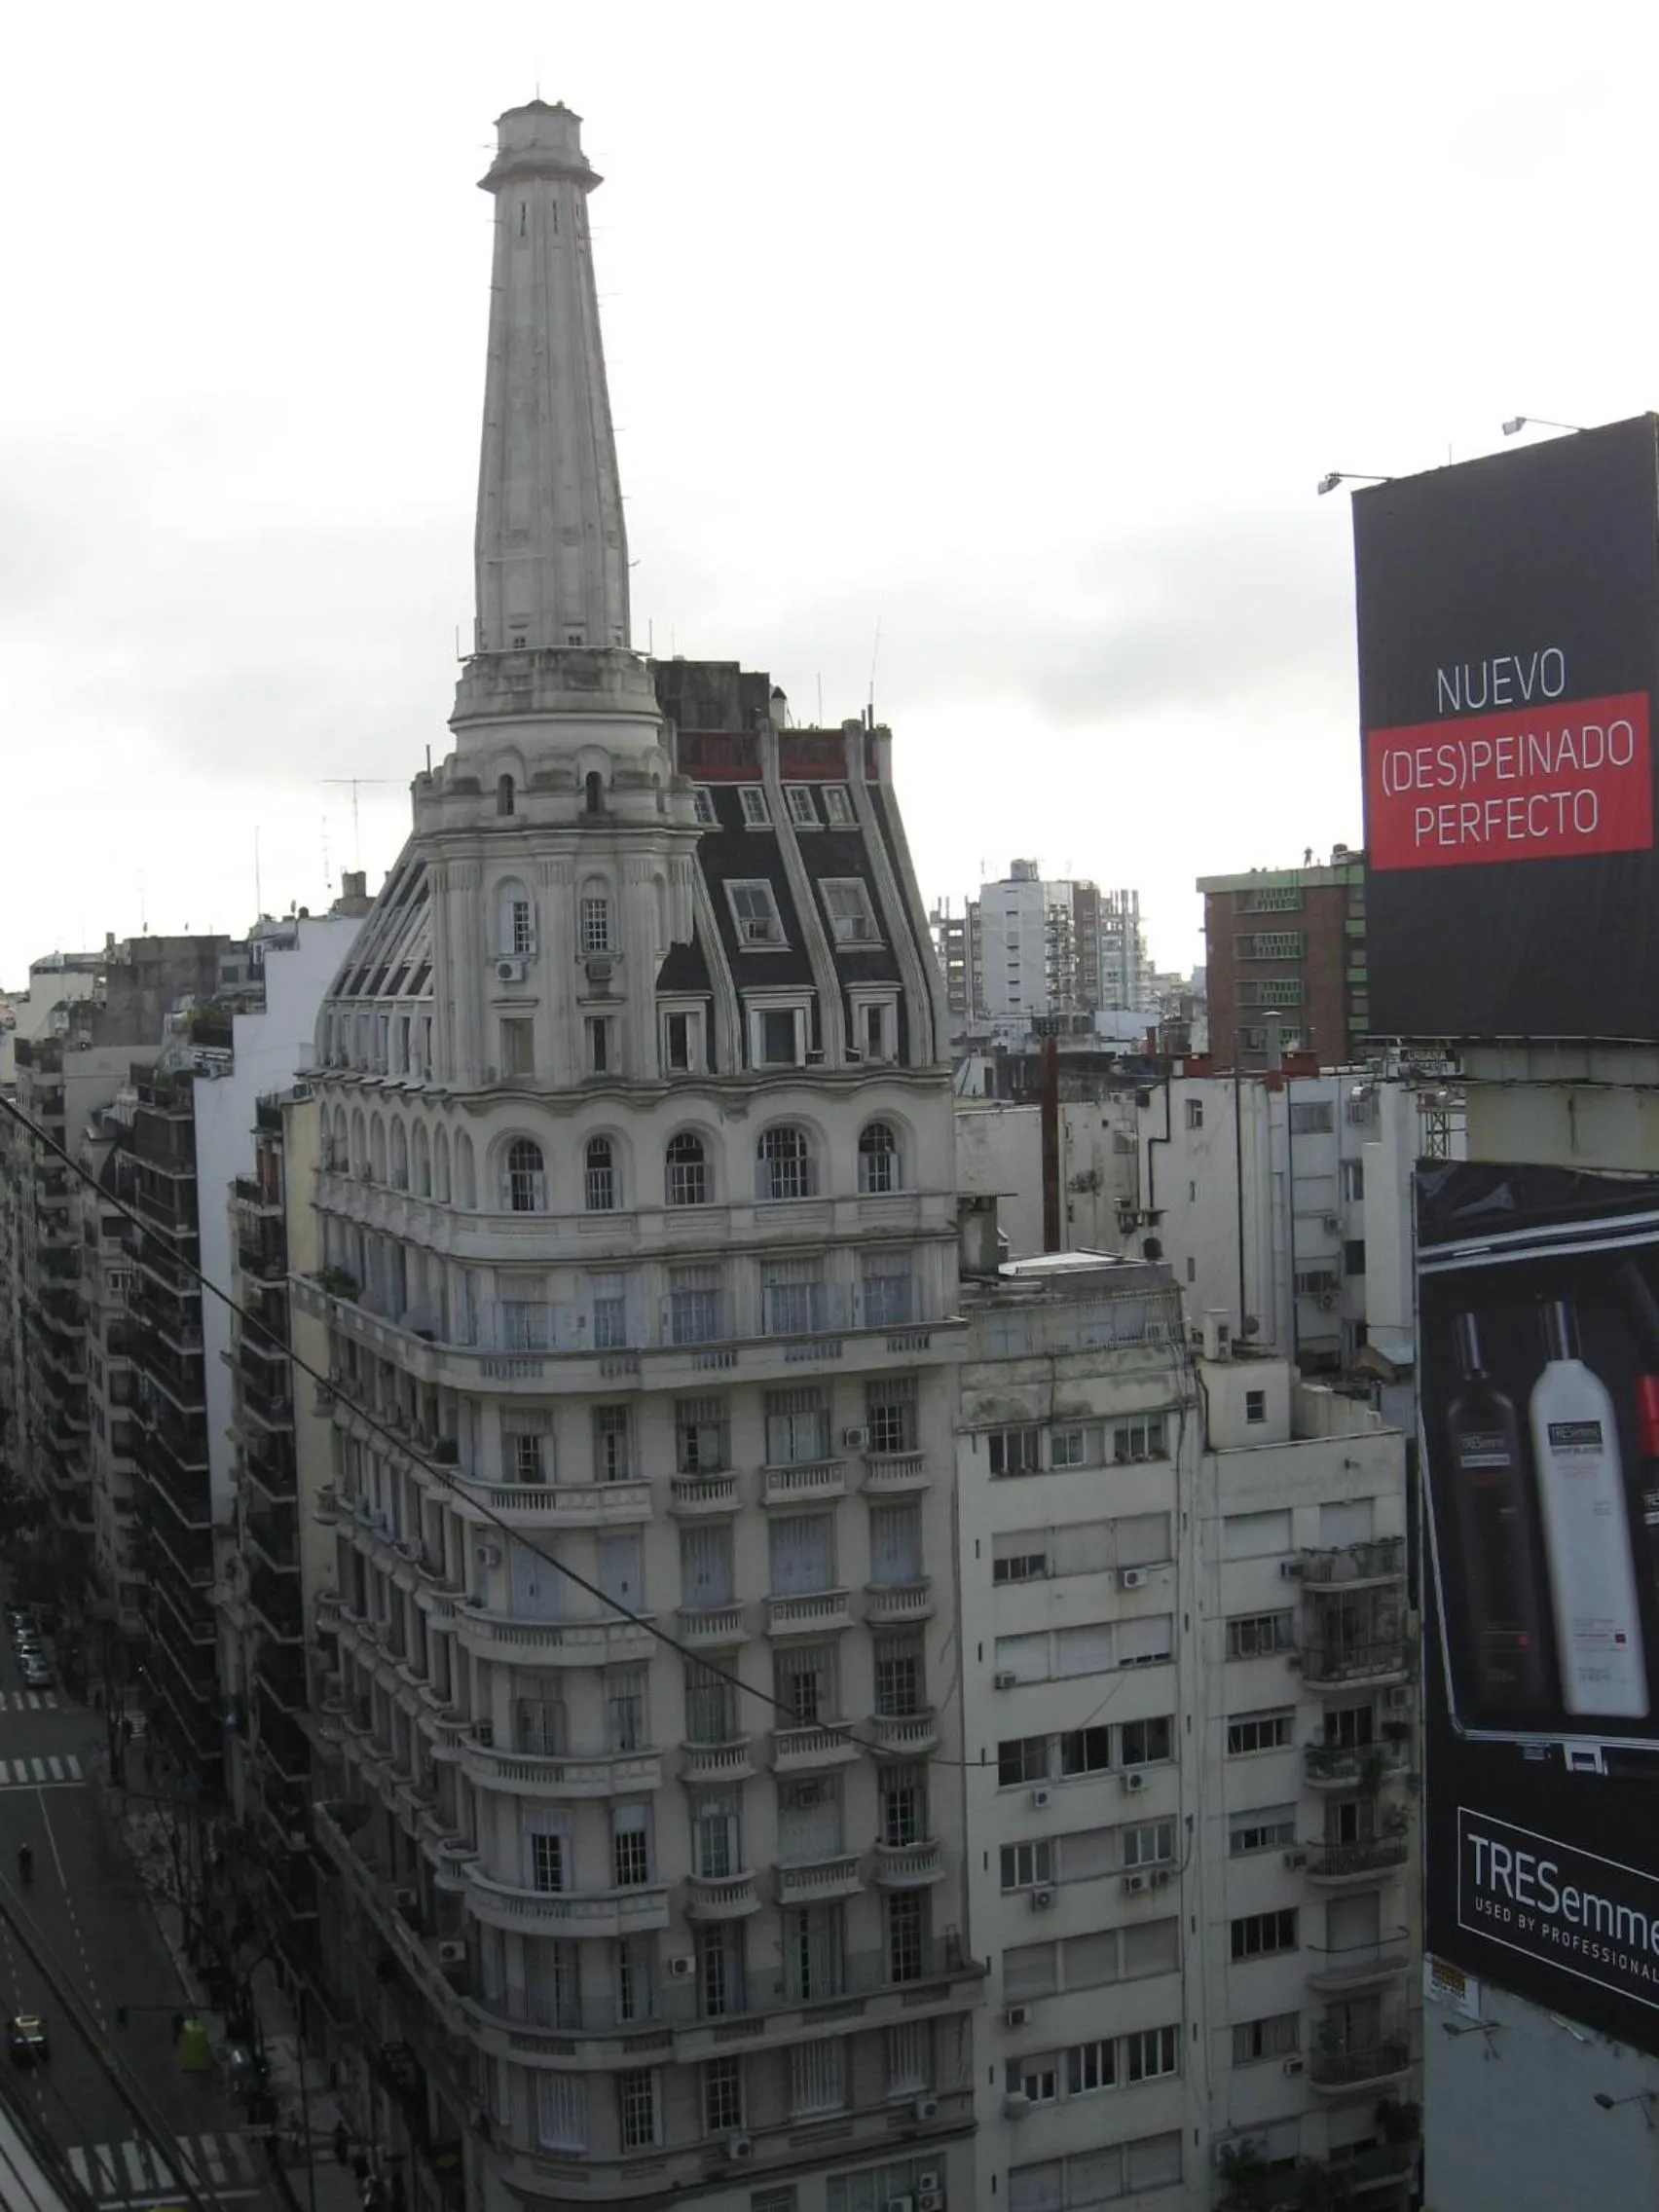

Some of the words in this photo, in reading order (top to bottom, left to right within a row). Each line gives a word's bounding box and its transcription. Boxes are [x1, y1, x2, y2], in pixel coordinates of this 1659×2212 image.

[1437, 647, 1565, 714] NUEVO
[1382, 720, 1634, 796] (DES)PEINADO
[1416, 789, 1599, 847] PERFECTO
[1475, 1897, 1512, 1922] USED
[1518, 1914, 1535, 1932] BY
